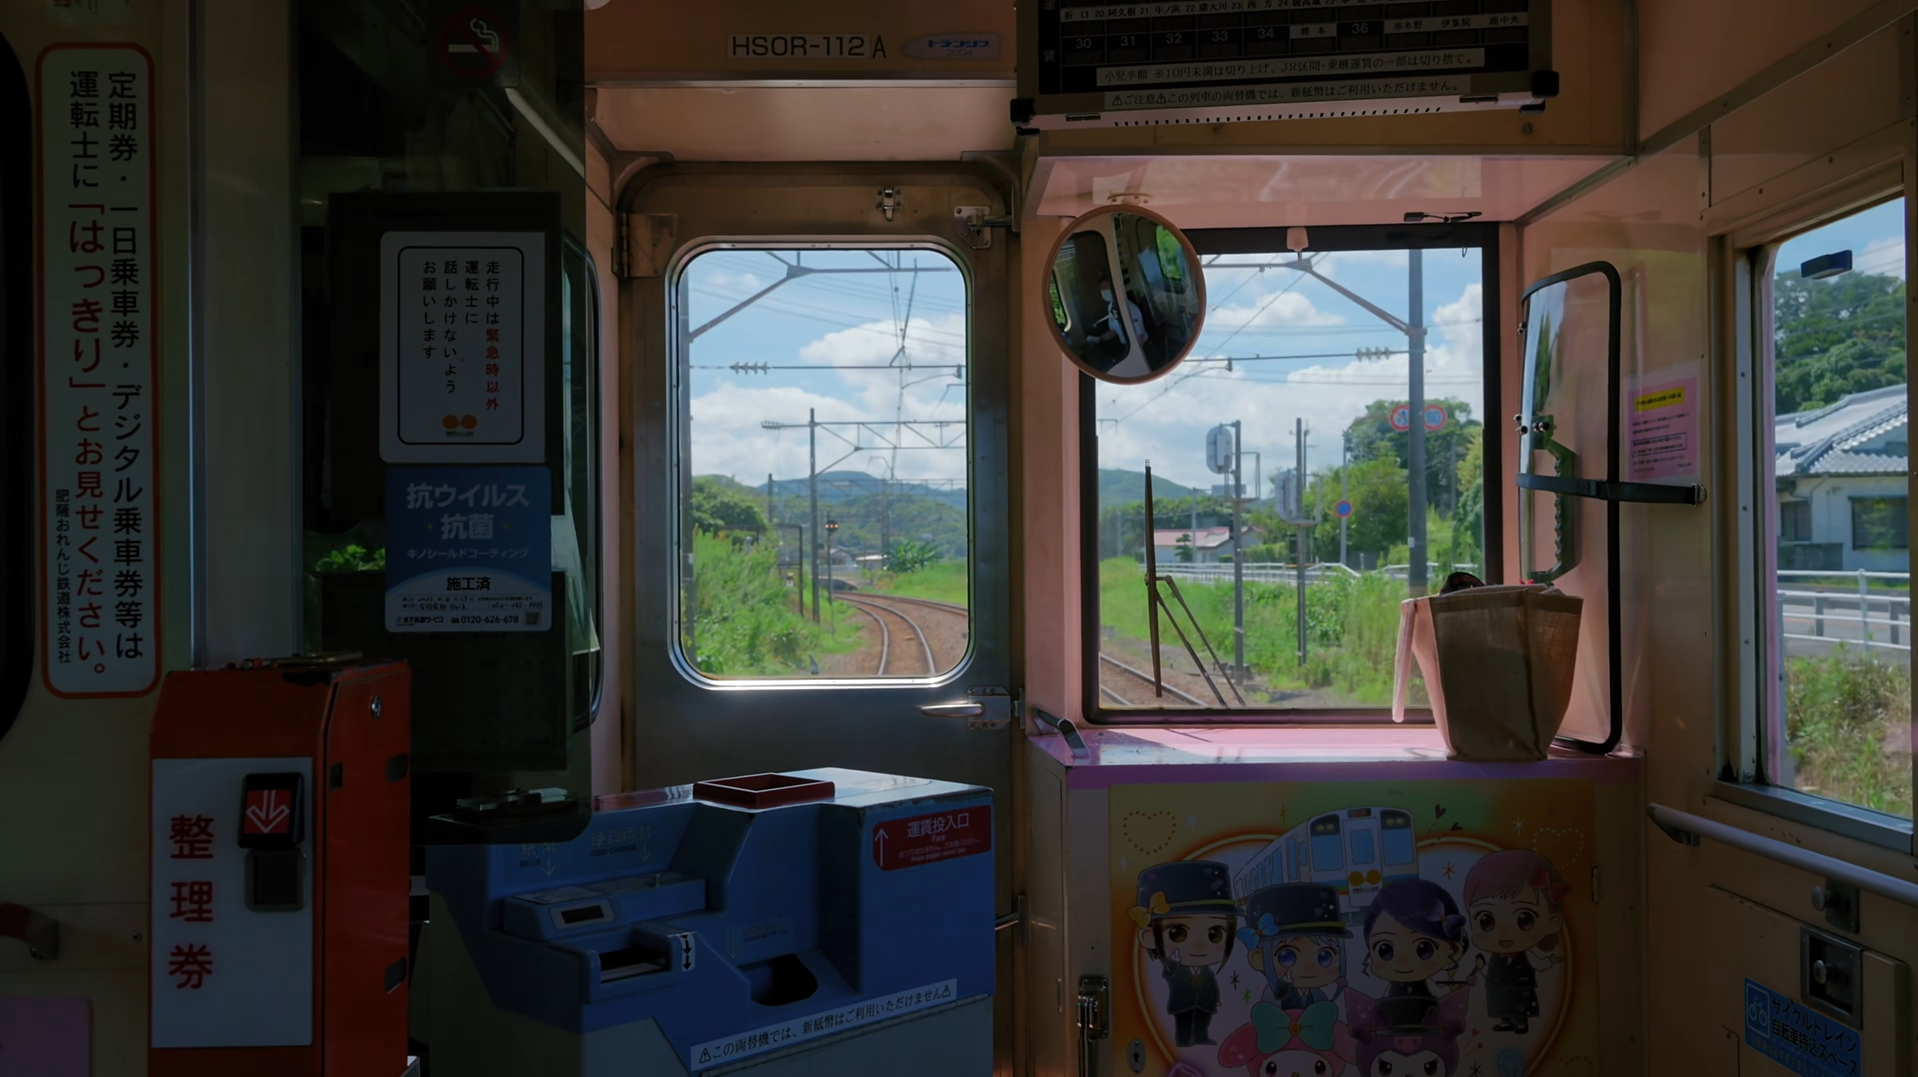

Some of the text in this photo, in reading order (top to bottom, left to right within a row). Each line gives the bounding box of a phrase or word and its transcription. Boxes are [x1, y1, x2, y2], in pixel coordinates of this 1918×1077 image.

[1107, 6, 1149, 19] 阿久根 21
[1185, 4, 1195, 13] 22
[1231, 2, 1241, 10] 23
[1094, 8, 1104, 18] 20
[1257, 28, 1275, 39] 34
[1351, 23, 1369, 34] 36
[1120, 36, 1136, 47] 31
[1165, 33, 1182, 44] 32
[1211, 30, 1229, 42] 33
[1075, 38, 1092, 49] 30
[465, 260, 480, 325] 運転士に
[422, 260, 437, 360] お願いします
[443, 260, 458, 395] 話しかけないよう
[486, 260, 500, 411] 走行中は緊急時以外
[407, 482, 529, 509] 抗ウイルス
[441, 513, 494, 540] 抗菌
[407, 548, 530, 560] キノシールドコーティング
[55, 488, 72, 664] 肥薩おれんじ鉄道株式会社
[447, 576, 492, 591] 施工済
[461, 615, 520, 624] 0120-626-678
[907, 813, 970, 838] 運賃投入口
[931, 834, 946, 843] Fare
[169, 814, 215, 989] 整理券
[1771, 996, 1857, 1053] サイクルトレイン
[1771, 1017, 1858, 1076] 自転車持込スペース
